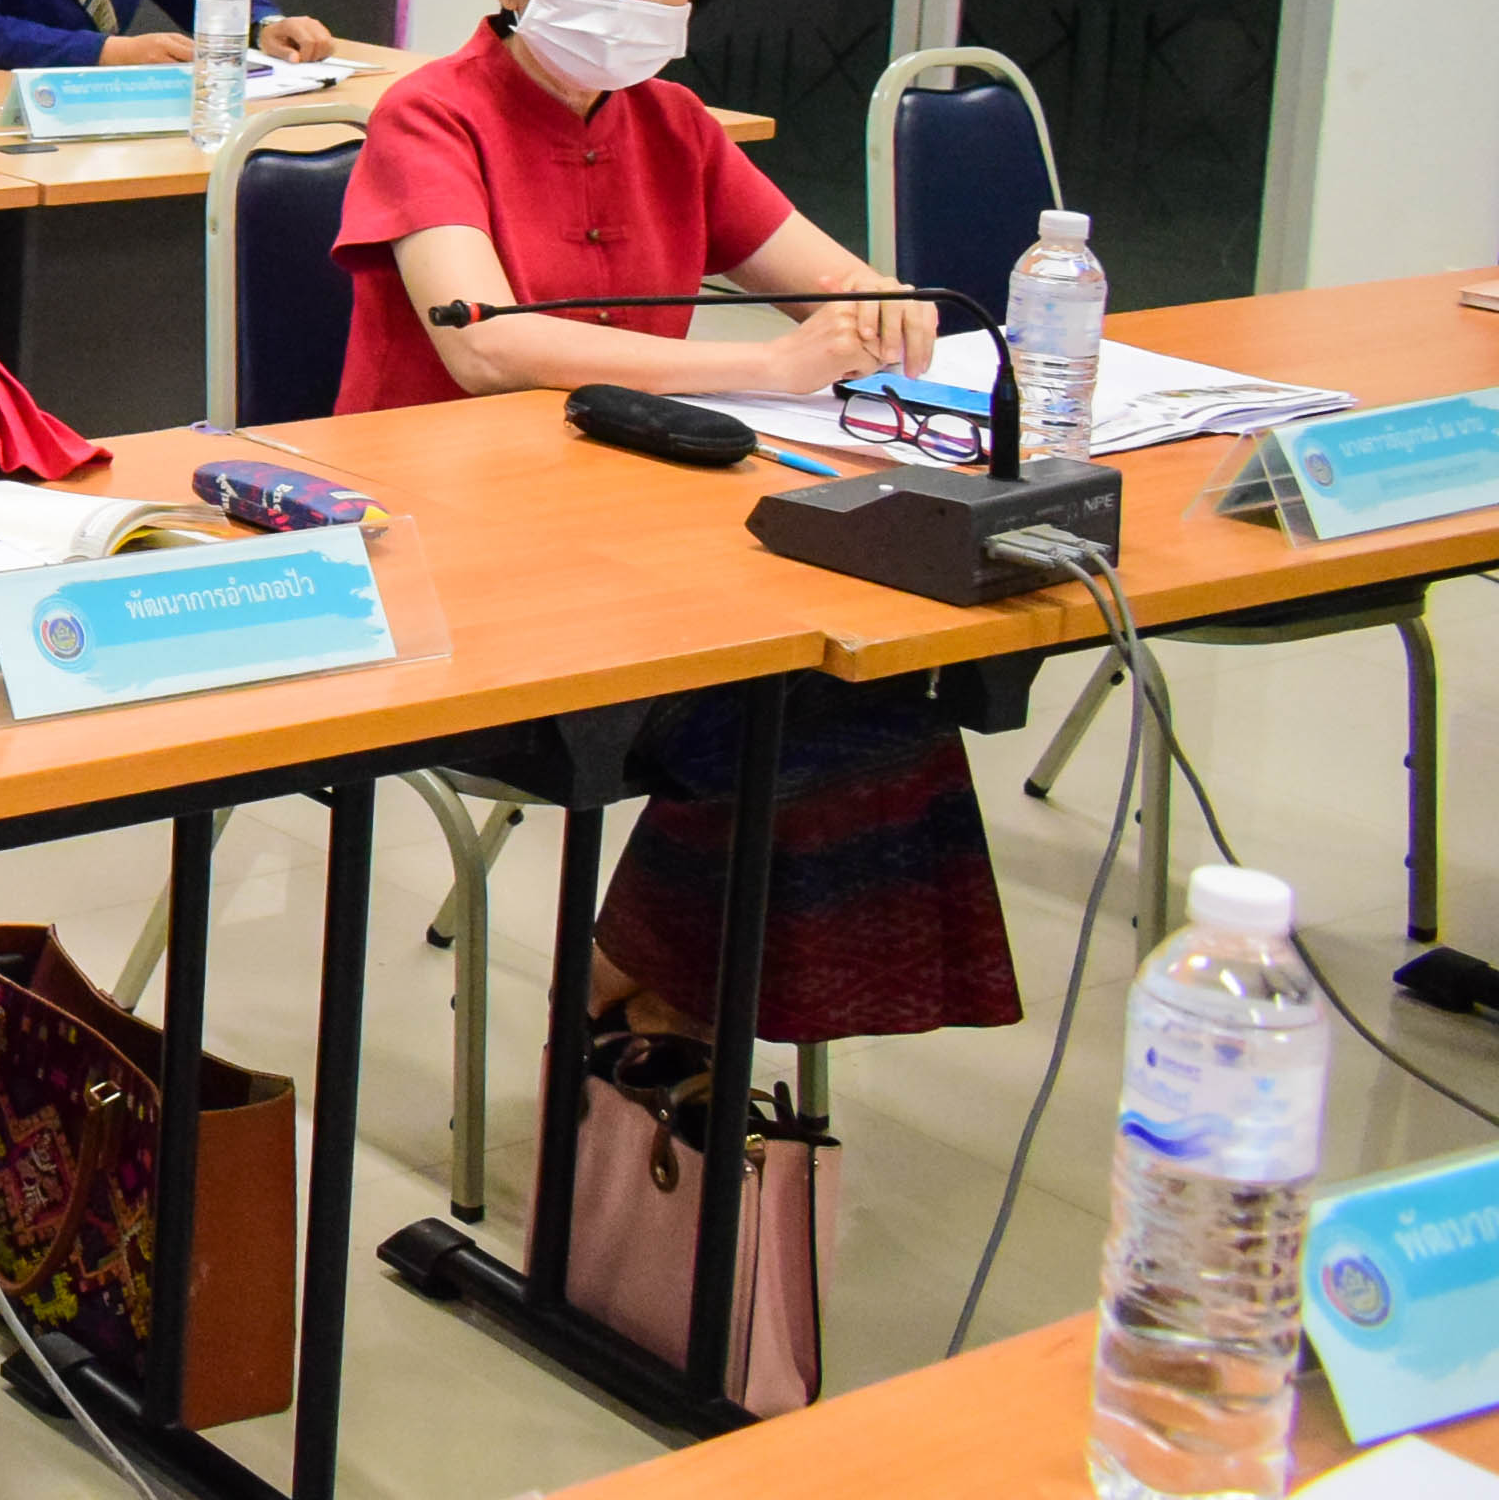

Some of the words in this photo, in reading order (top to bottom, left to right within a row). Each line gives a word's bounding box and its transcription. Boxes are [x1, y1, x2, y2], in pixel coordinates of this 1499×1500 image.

[1084, 492, 1115, 511] NPE
[124, 567, 316, 619] พัฒนาการอำเภอปัว
